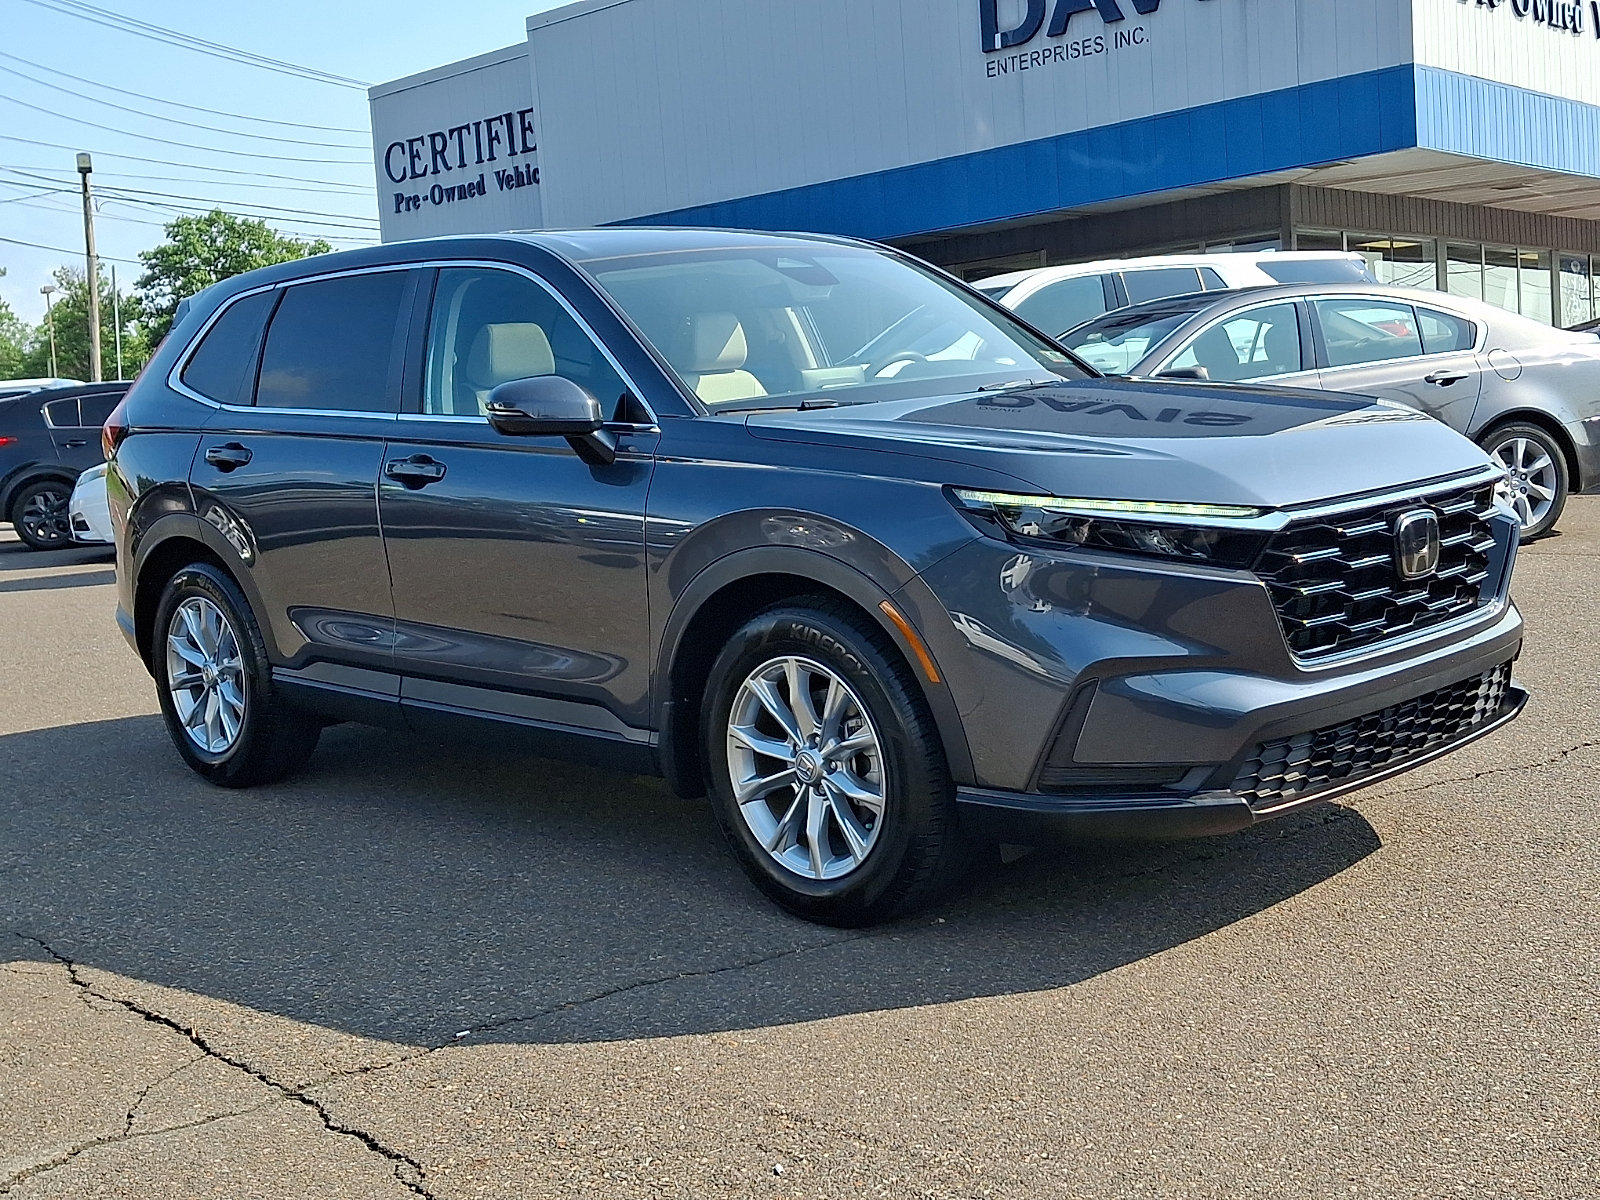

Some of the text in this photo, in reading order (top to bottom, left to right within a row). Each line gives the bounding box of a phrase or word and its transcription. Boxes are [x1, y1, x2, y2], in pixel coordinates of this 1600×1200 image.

[986, 26, 1150, 78] ENTERPRISES, INC.
[384, 107, 537, 184] CERTIFIE
[394, 163, 541, 214] Pre-Owned Vehic
